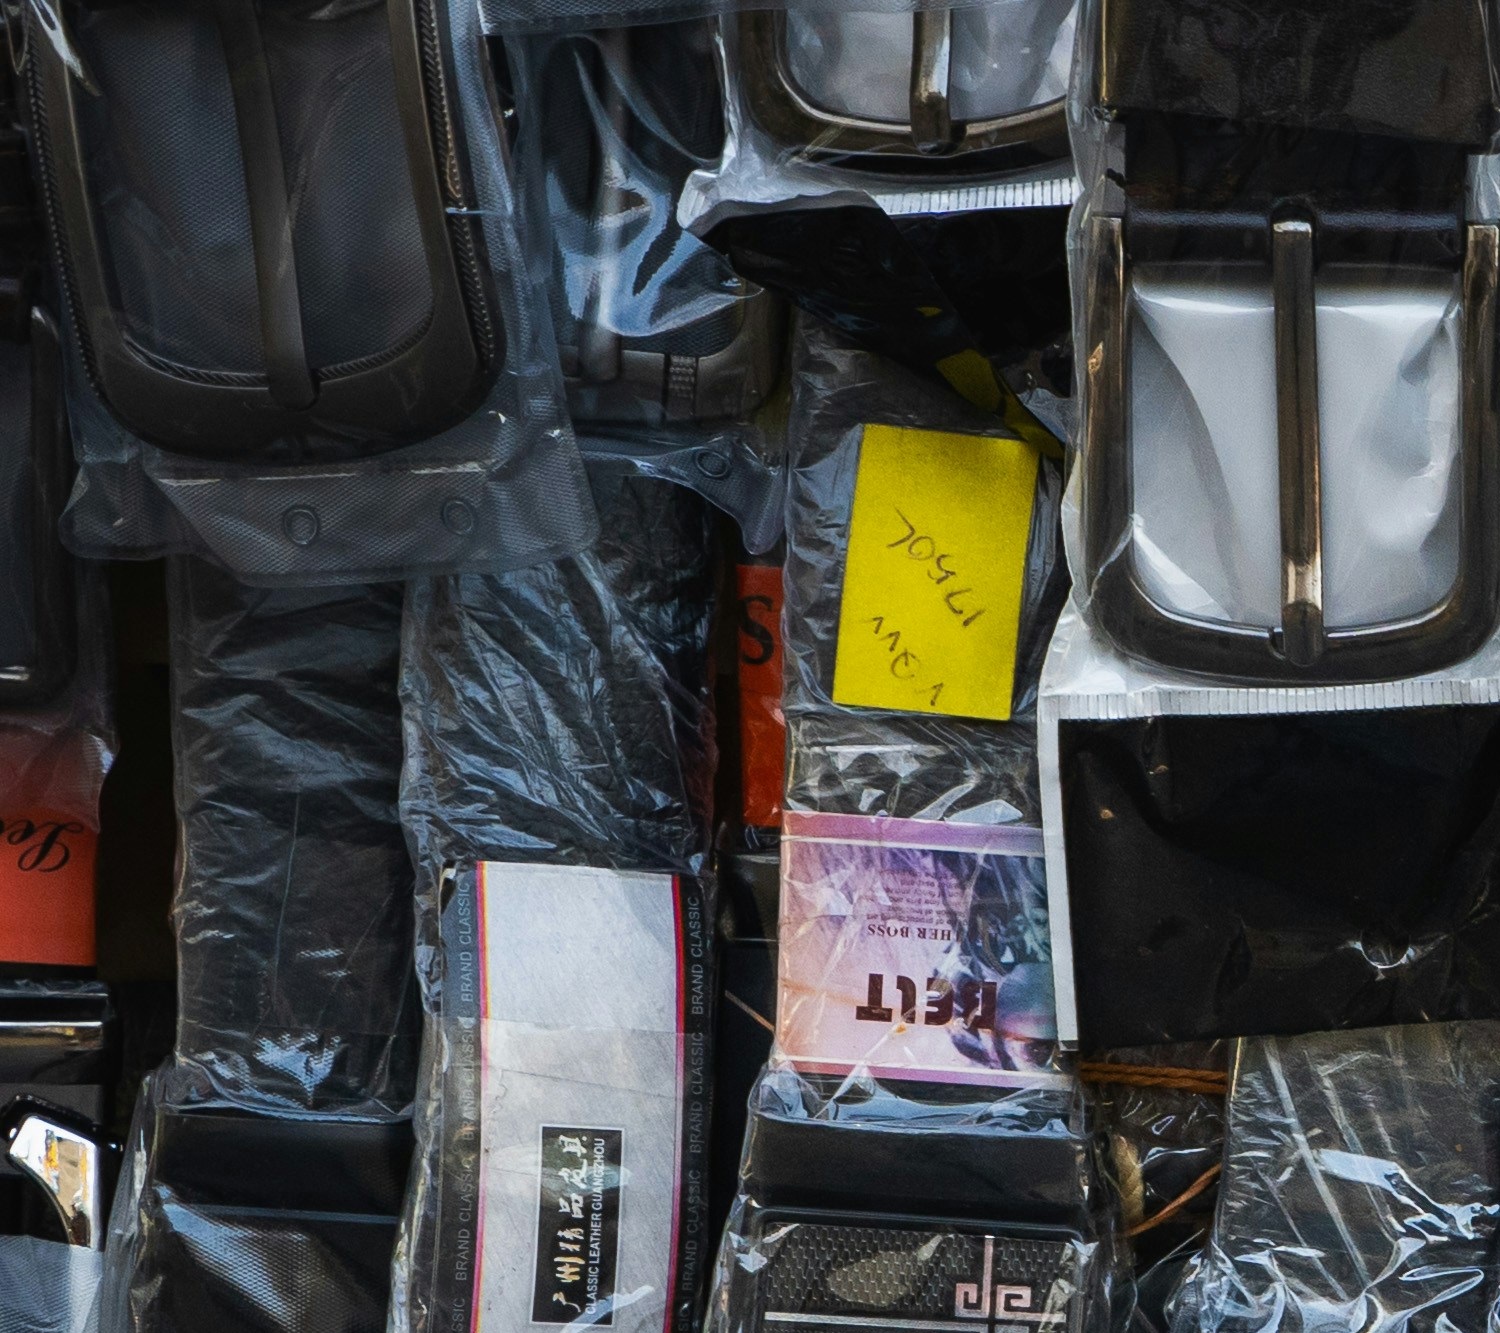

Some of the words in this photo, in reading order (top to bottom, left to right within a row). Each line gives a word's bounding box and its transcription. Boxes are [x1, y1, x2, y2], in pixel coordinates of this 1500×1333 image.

[456, 882, 472, 944] CLASSIC
[687, 896, 702, 958] CLASSIC
[867, 924, 909, 938] BOSS
[459, 951, 474, 1002] BRAND
[690, 964, 704, 1015] BRAND
[856, 973, 997, 1031] BELT
[690, 1031, 704, 1095] CLASSIC
[688, 1100, 704, 1153] BRAND
[590, 1138, 605, 1210] GUANGZHOU
[686, 1169, 702, 1233] CLASSIC
[455, 1228, 471, 1281] BRAND
[588, 1213, 602, 1264] LEATHER
[585, 1267, 600, 1314] CLASSIC
